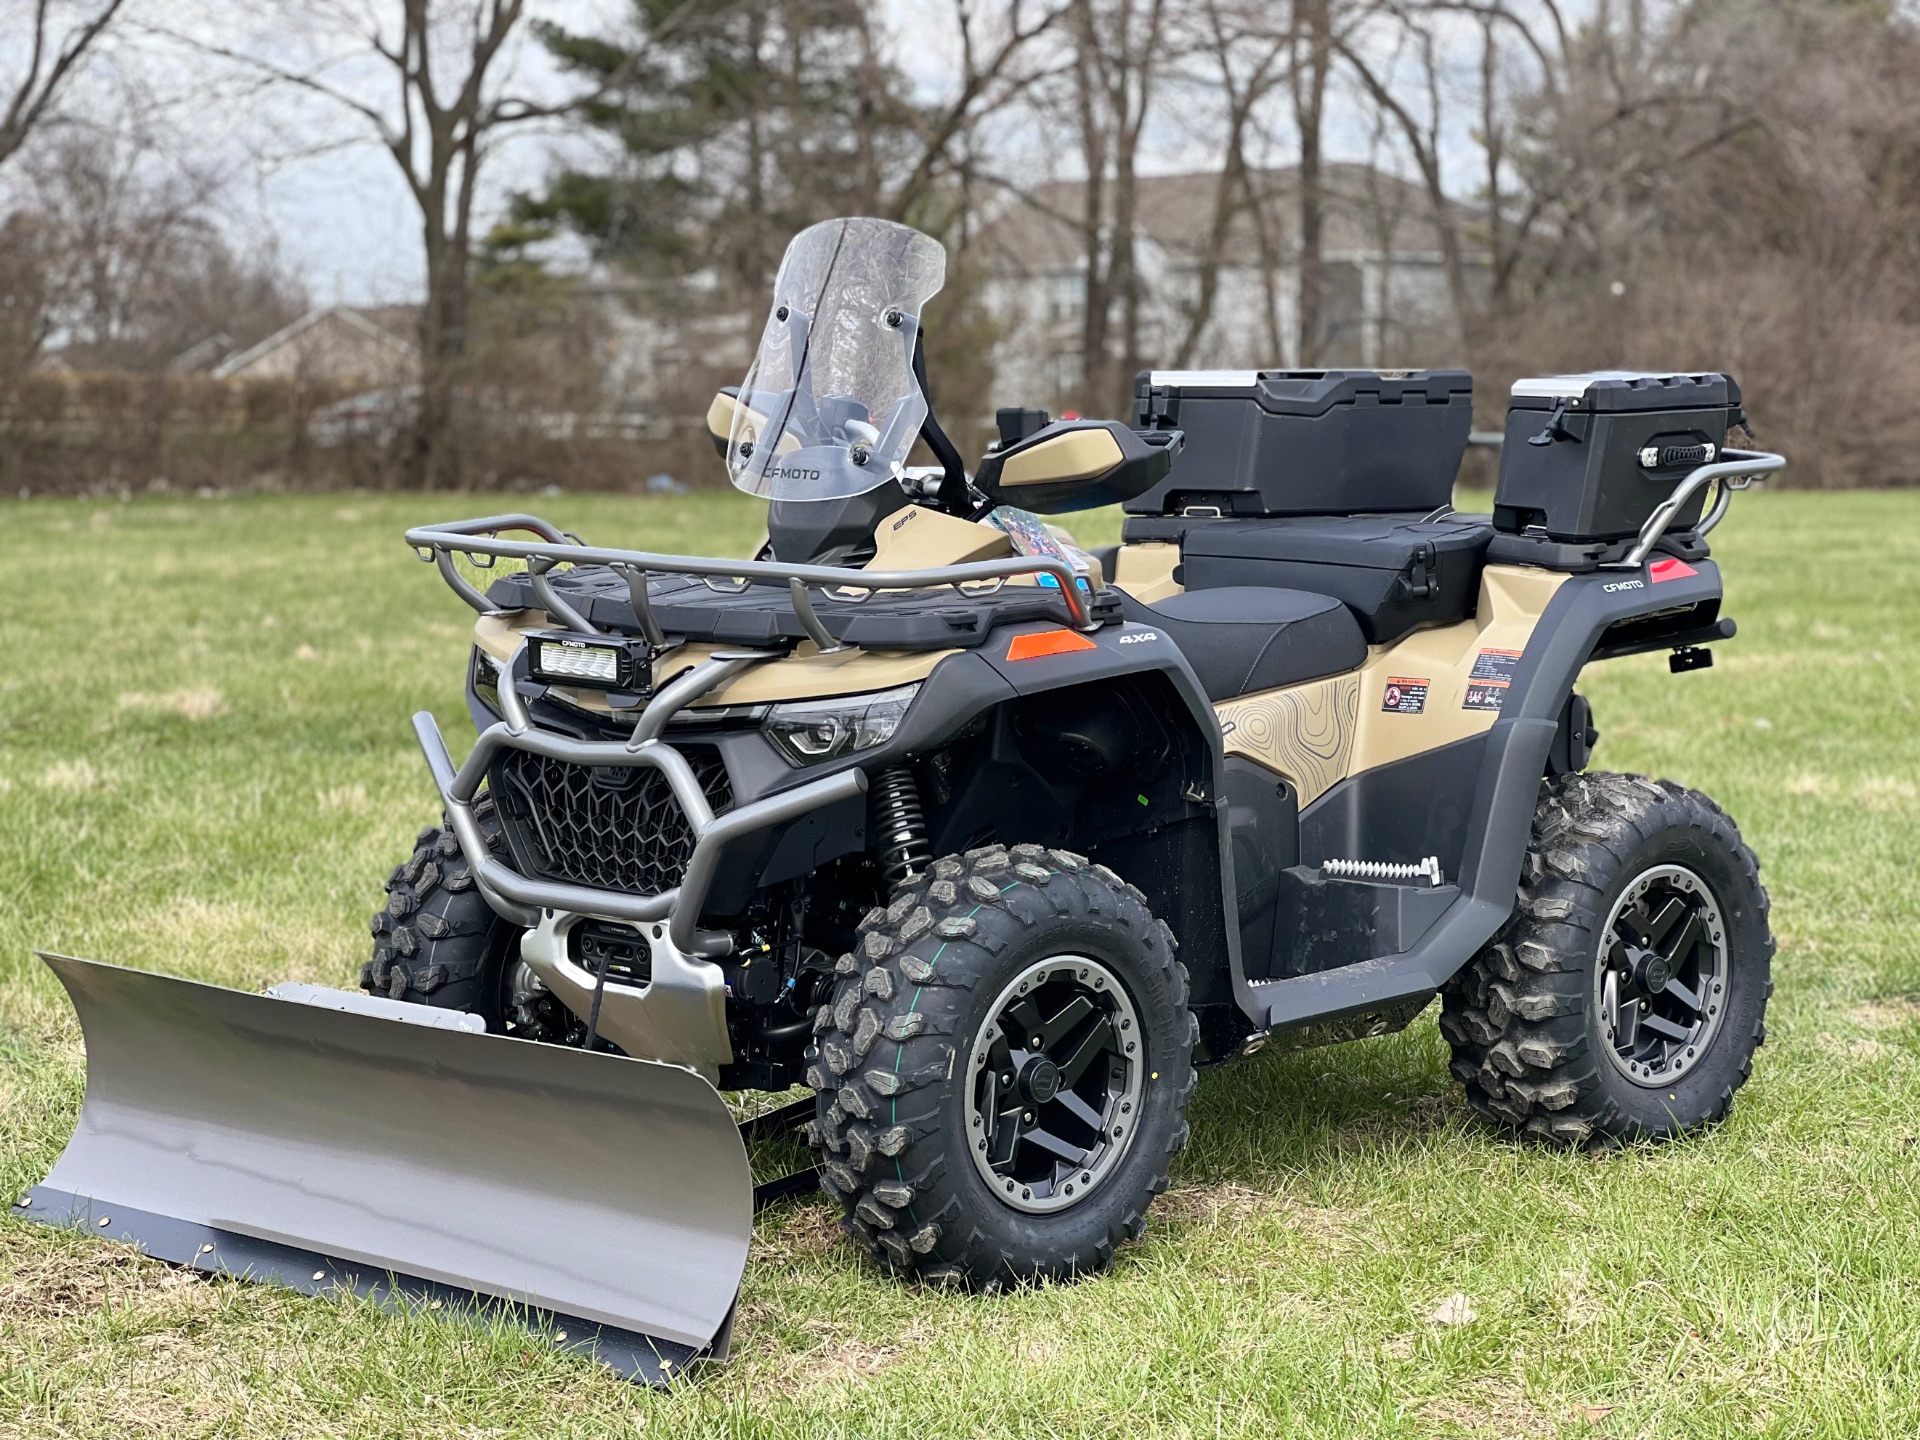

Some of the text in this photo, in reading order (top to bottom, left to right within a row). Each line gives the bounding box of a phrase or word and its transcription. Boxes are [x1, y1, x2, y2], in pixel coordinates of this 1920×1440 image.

[762, 467, 820, 480] CFMOTO
[893, 509, 917, 531] EPS
[1602, 580, 1644, 593] CFMOTO
[561, 640, 586, 648] CFMOTO
